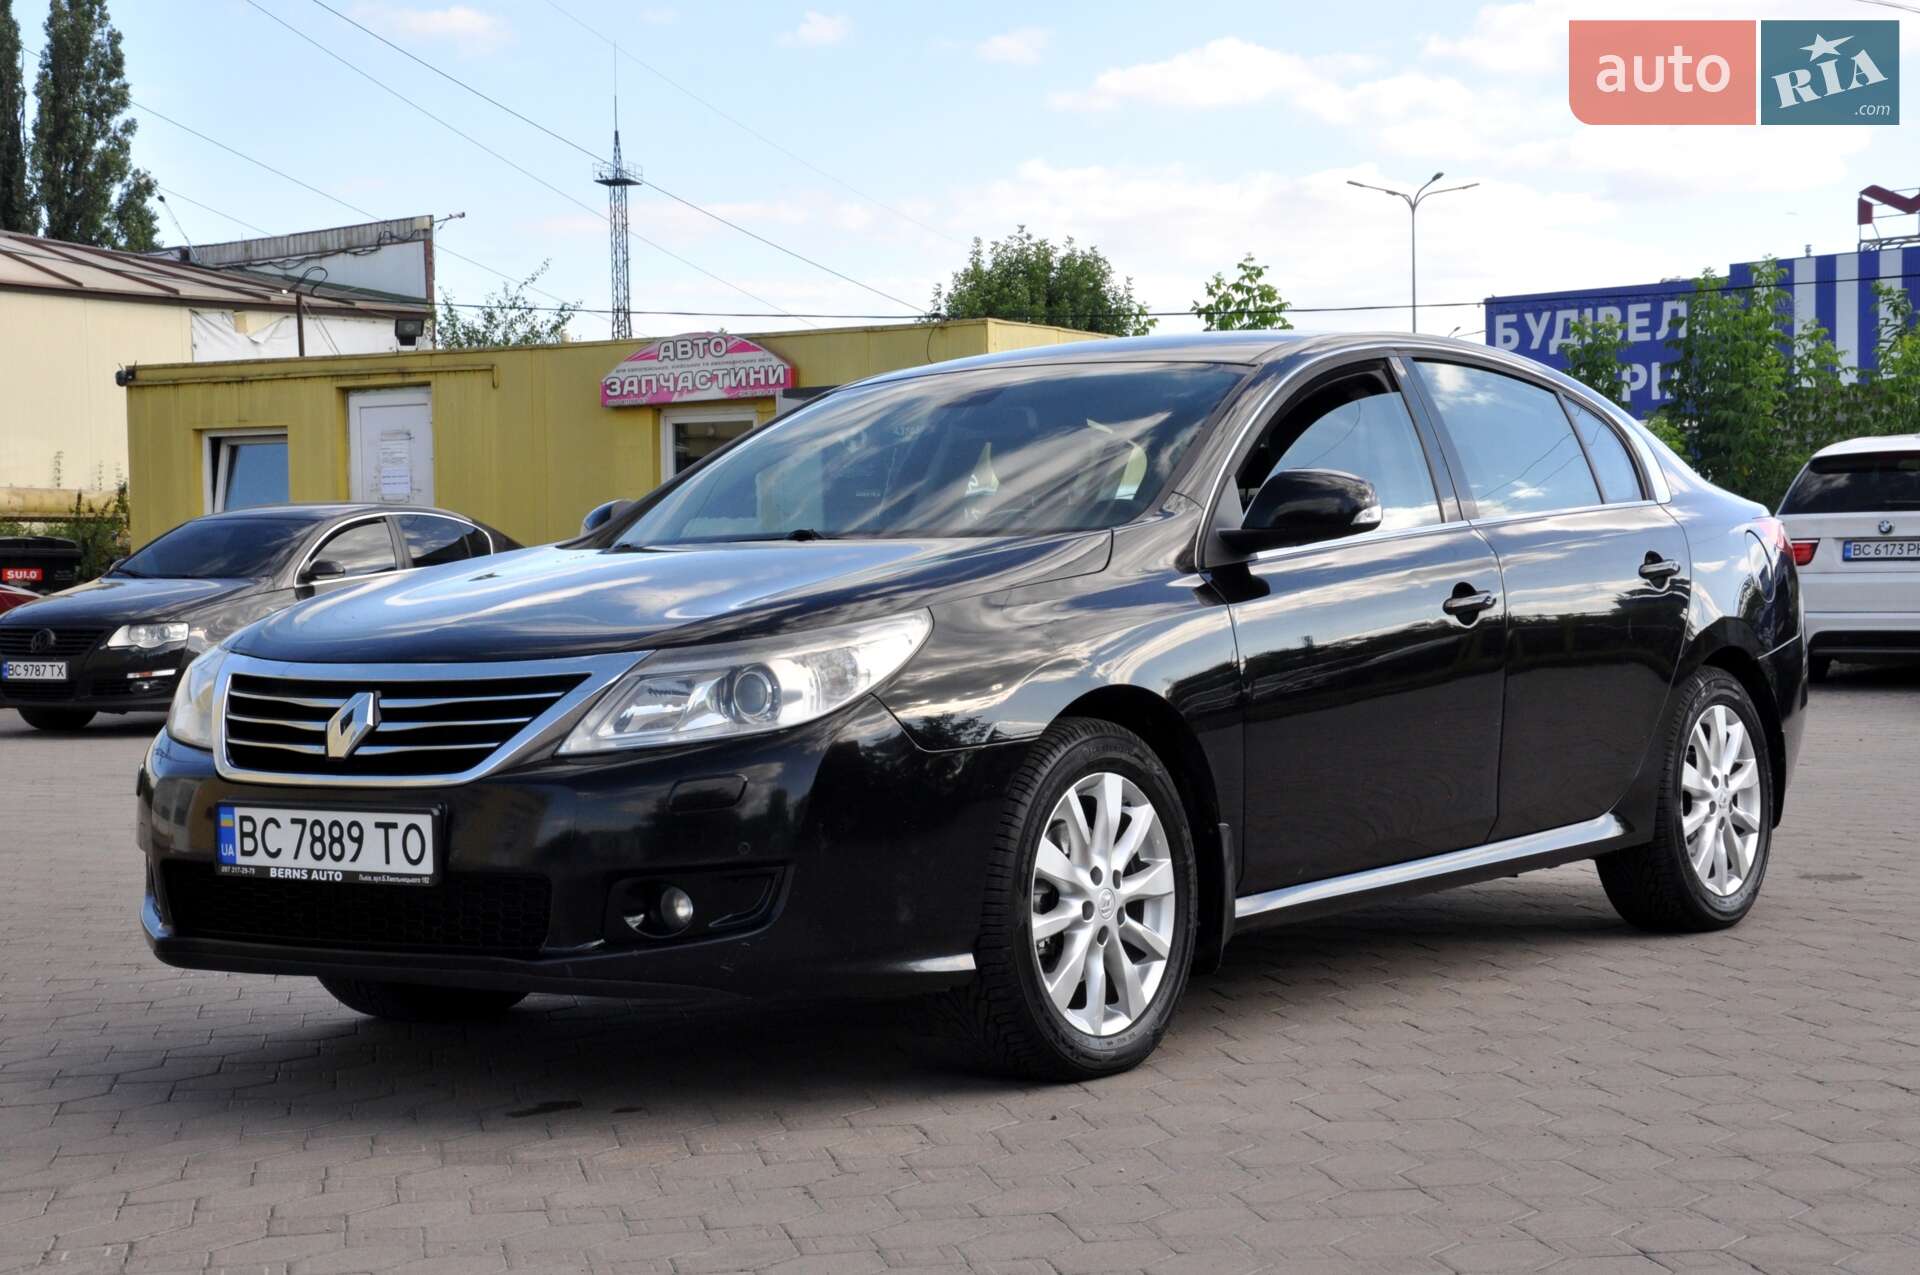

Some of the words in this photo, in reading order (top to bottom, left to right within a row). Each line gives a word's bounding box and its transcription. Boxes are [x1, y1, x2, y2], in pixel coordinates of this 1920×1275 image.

[1494, 299, 1688, 356] БУДІВЕЛ
[657, 336, 728, 362] АВТО
[604, 364, 785, 397] ЗАПЧАСТИНИ
[1853, 543, 1871, 556] BC
[1874, 543, 1904, 556] 6173
[8, 664, 21, 677] BC
[23, 664, 47, 677] 9787
[48, 664, 64, 677] TX
[239, 815, 282, 859] BC
[290, 818, 364, 862] 7889
[374, 821, 426, 866] TO
[221, 844, 235, 858] UA
[269, 867, 309, 880] BERNS
[311, 869, 343, 882] AUTO
